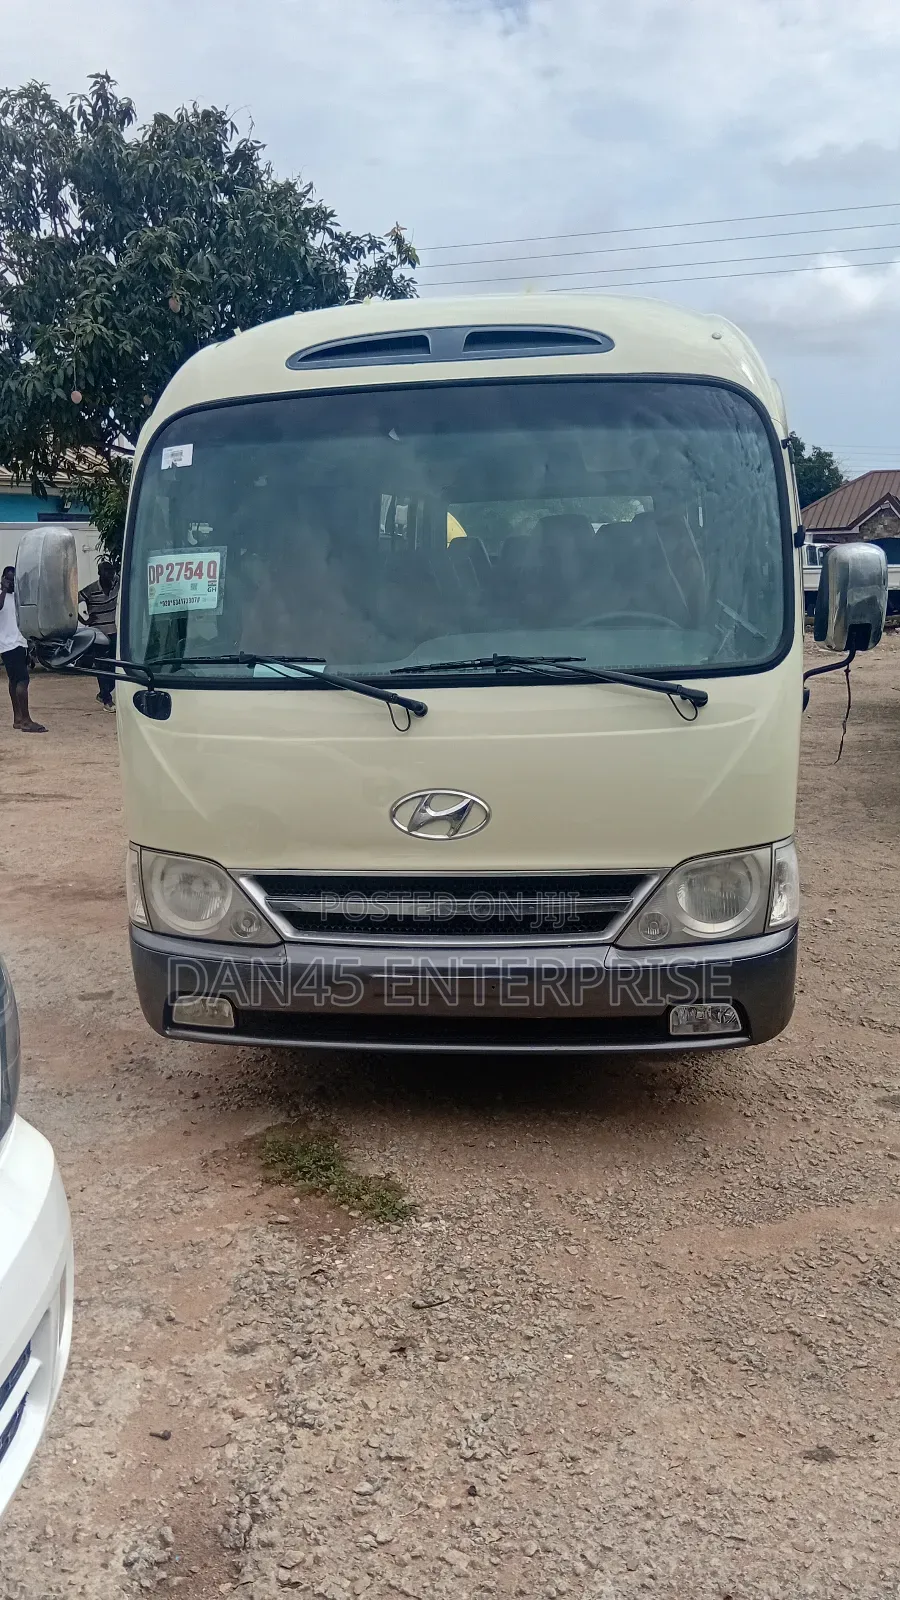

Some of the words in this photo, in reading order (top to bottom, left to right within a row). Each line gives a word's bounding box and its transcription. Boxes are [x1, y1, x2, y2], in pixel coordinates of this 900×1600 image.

[149, 564, 164, 585] DP
[166, 561, 203, 582] 2754
[207, 560, 217, 579] Q
